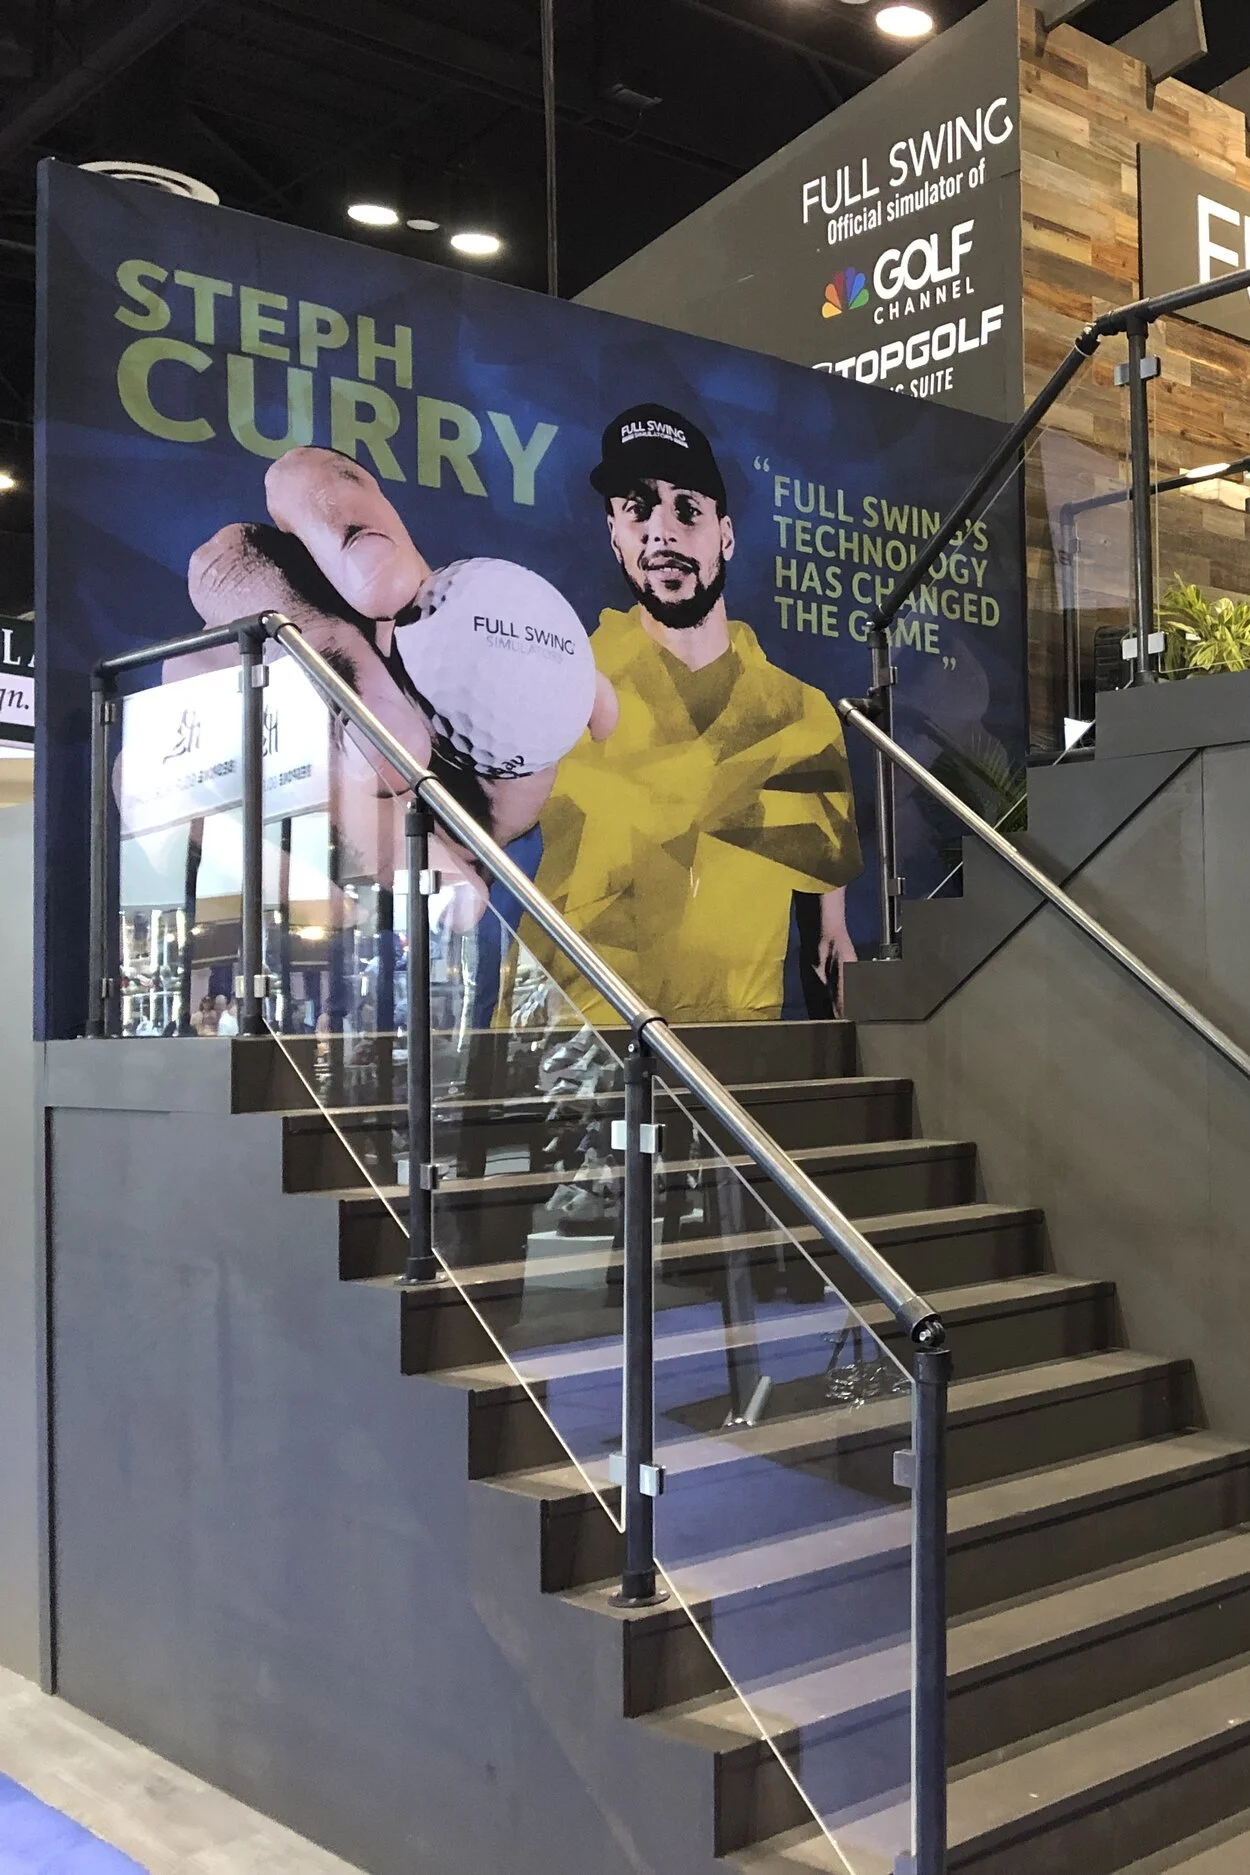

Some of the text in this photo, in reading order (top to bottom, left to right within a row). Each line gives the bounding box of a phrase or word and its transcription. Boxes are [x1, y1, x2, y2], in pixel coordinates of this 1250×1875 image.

[803, 97, 1014, 223] FULL SWING
[828, 157, 986, 245] Official simulator of
[873, 220, 974, 299] GOLF
[114, 259, 413, 389] STEPH
[874, 277, 974, 324] CHANNEL
[835, 305, 1004, 386] TOPGOLF
[910, 367, 954, 398] SUITE
[117, 336, 559, 506] CURRY
[621, 420, 686, 441] FULL SWING
[862, 496, 989, 552] SWIN'S
[774, 596, 839, 638] THE
[775, 556, 1000, 627] HAS CHANGED
[474, 616, 575, 655] FULL SWING
